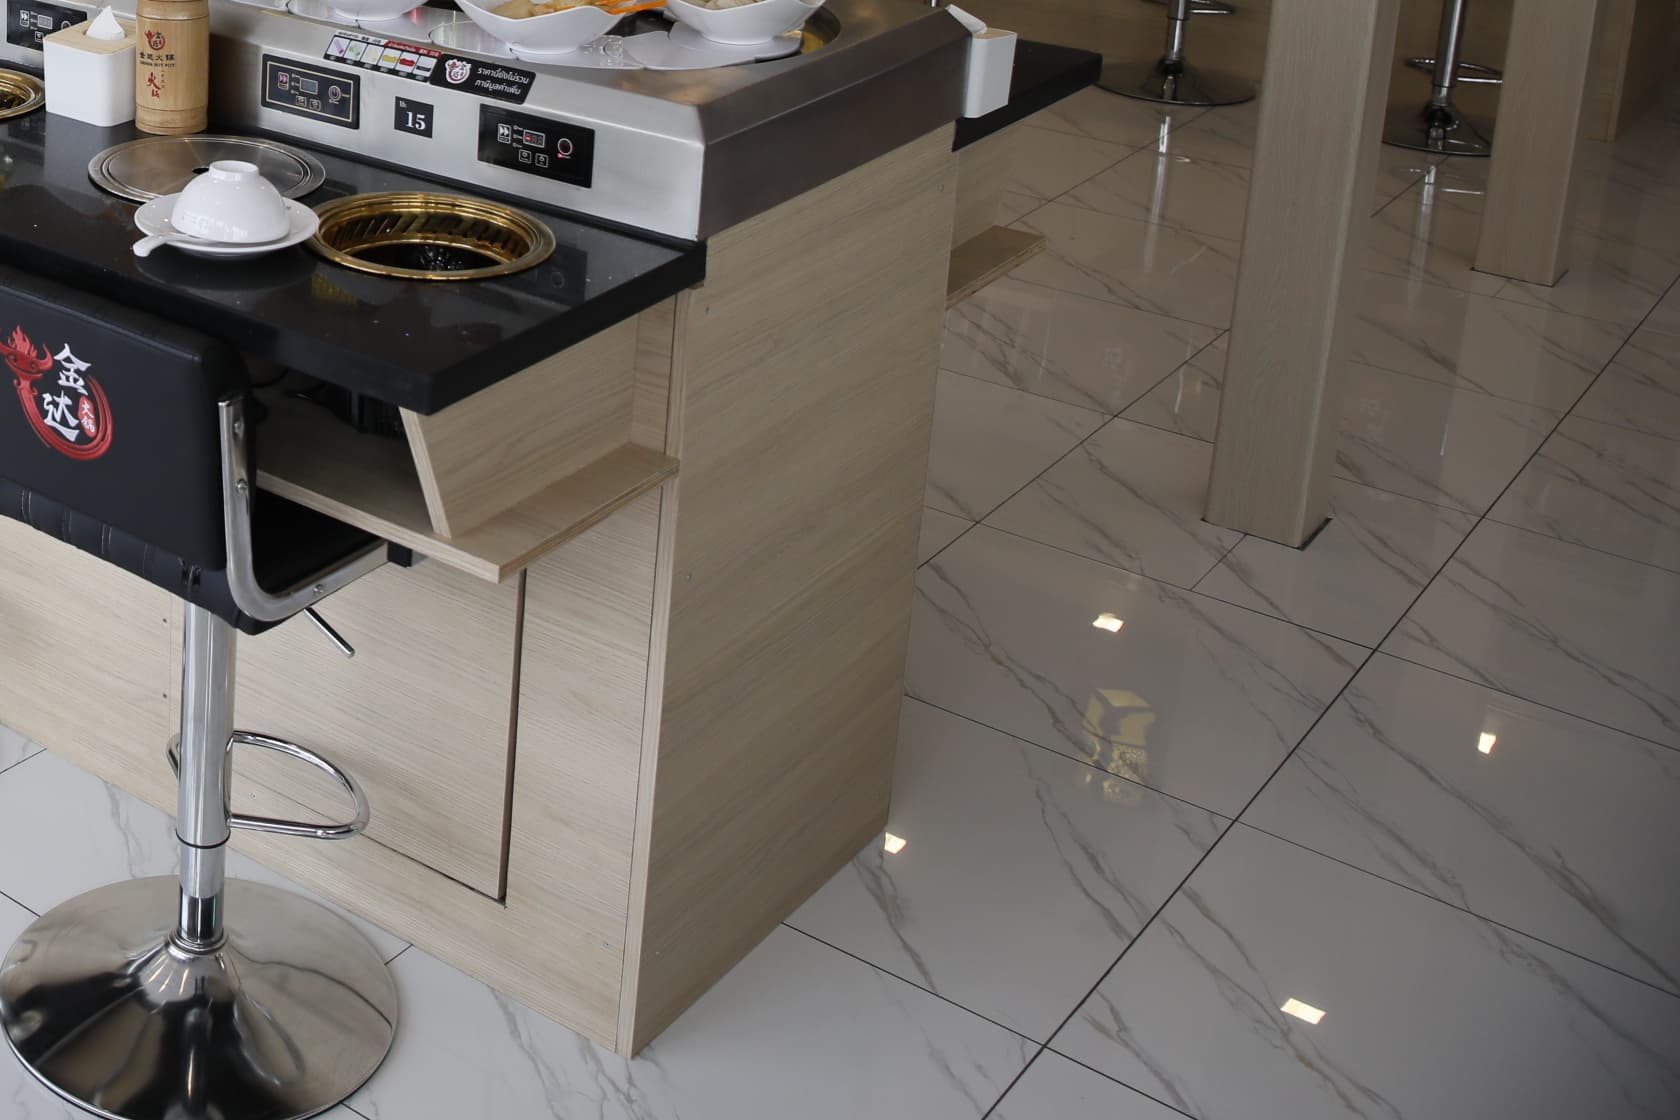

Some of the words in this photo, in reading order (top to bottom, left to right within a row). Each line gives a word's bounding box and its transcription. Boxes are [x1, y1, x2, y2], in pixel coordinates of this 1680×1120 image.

[476, 67, 530, 84] ราคานี้ยังไม่รวม
[405, 111, 426, 131] 15
[43, 343, 93, 443] 金达
